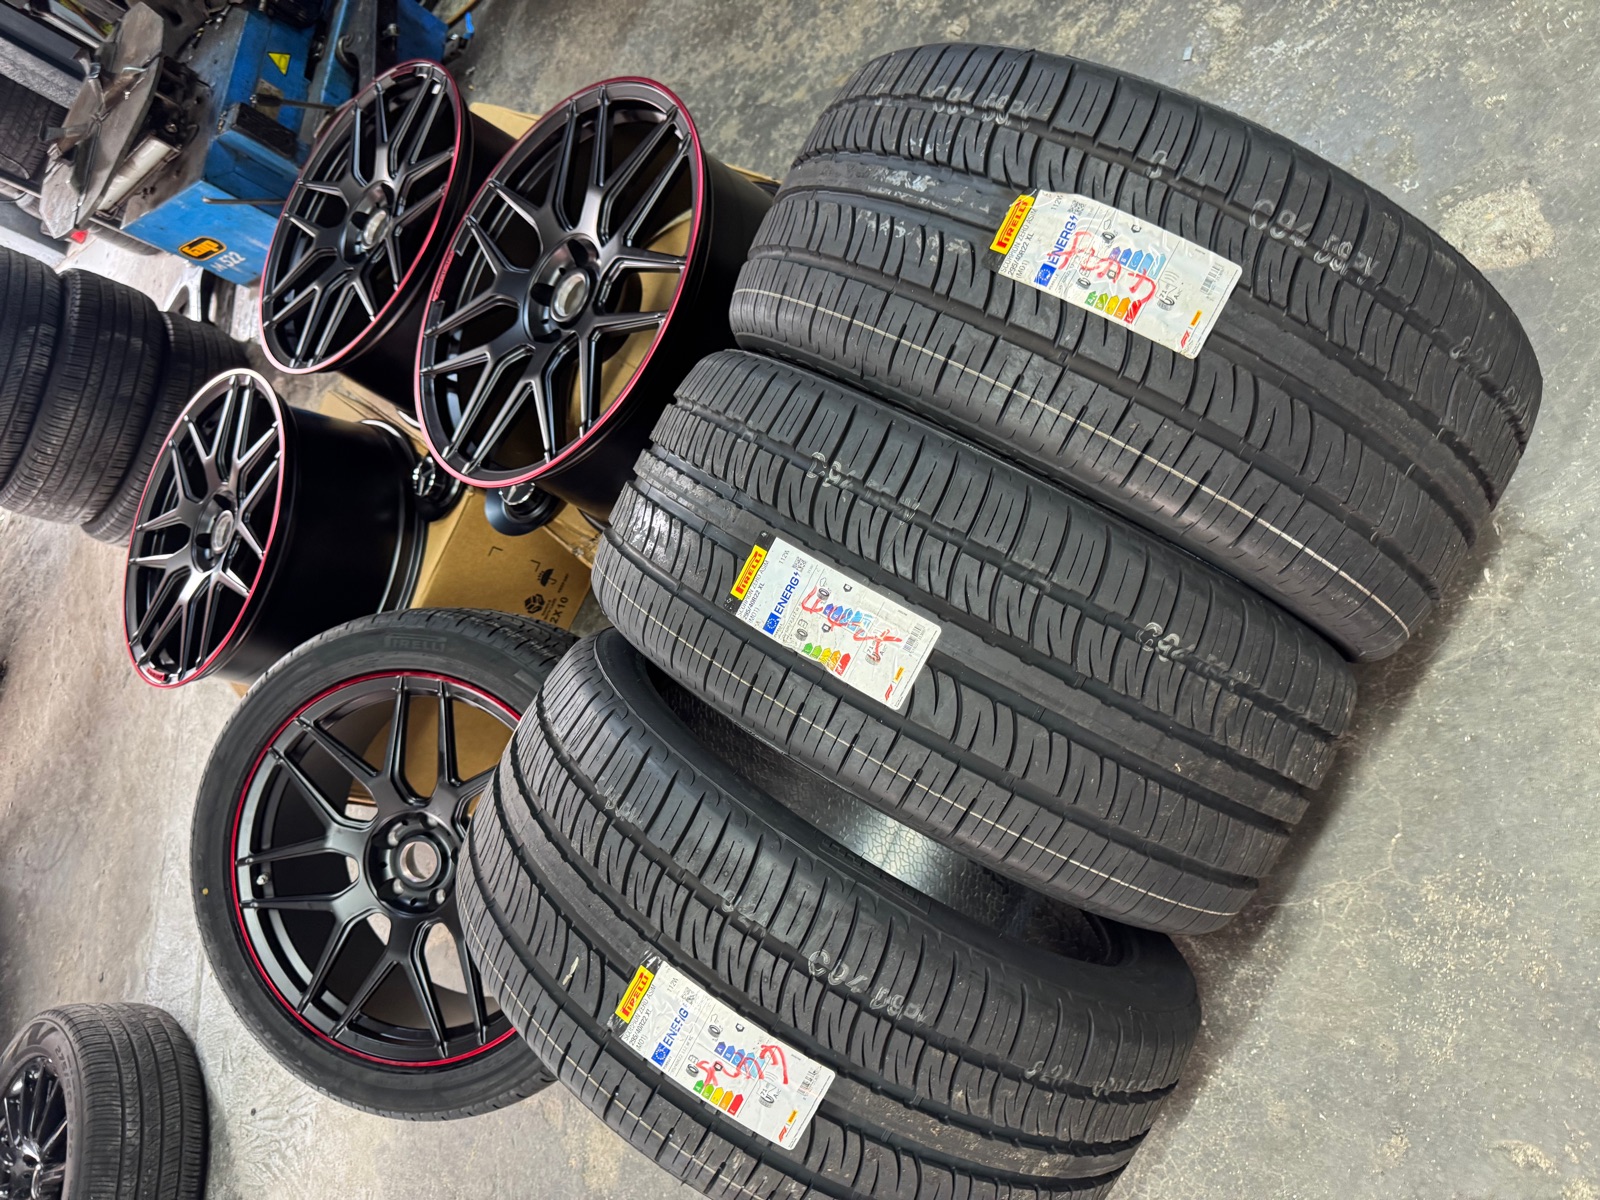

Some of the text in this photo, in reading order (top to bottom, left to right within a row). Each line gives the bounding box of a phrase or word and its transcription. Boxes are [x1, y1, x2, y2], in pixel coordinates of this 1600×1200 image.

[995, 197, 1029, 249] PIRELLI
[1046, 219, 1077, 265] ENERG
[219, 251, 246, 267] 522
[1006, 231, 1034, 276] 295/40R22 XL
[734, 550, 763, 594] PIRELLI
[741, 580, 765, 620] 295/40R22 XL
[773, 575, 800, 615] ENERG
[383, 632, 447, 652] PIRELLI
[619, 970, 650, 1016] PIRELLI
[627, 1014, 649, 1046] 295/40R22
